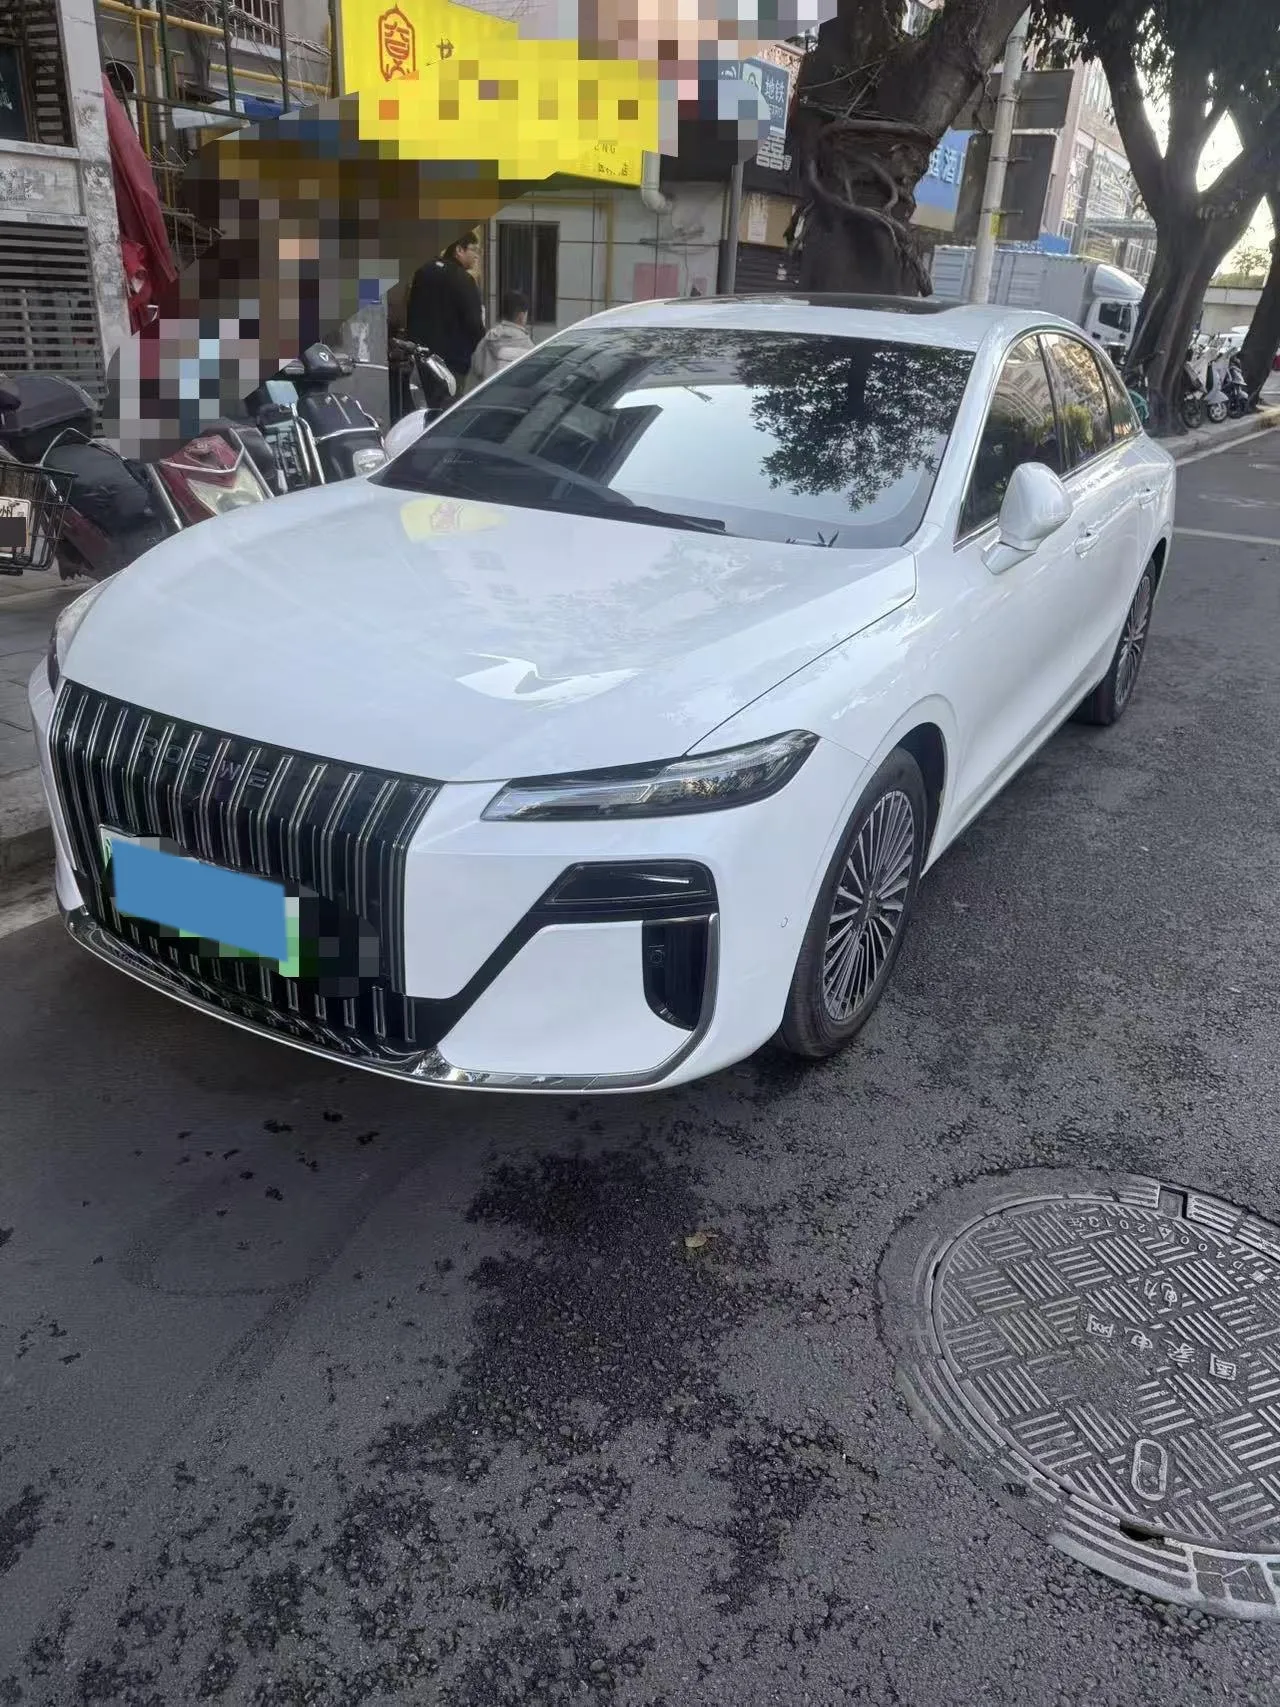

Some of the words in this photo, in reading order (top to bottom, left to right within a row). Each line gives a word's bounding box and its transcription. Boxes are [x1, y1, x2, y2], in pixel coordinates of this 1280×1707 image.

[765, 76, 785, 103] 地铁
[140, 735, 270, 789] ROEWE
[1143, 1278, 1178, 1308] 电力
[1085, 1313, 1237, 1381] 国家电网
